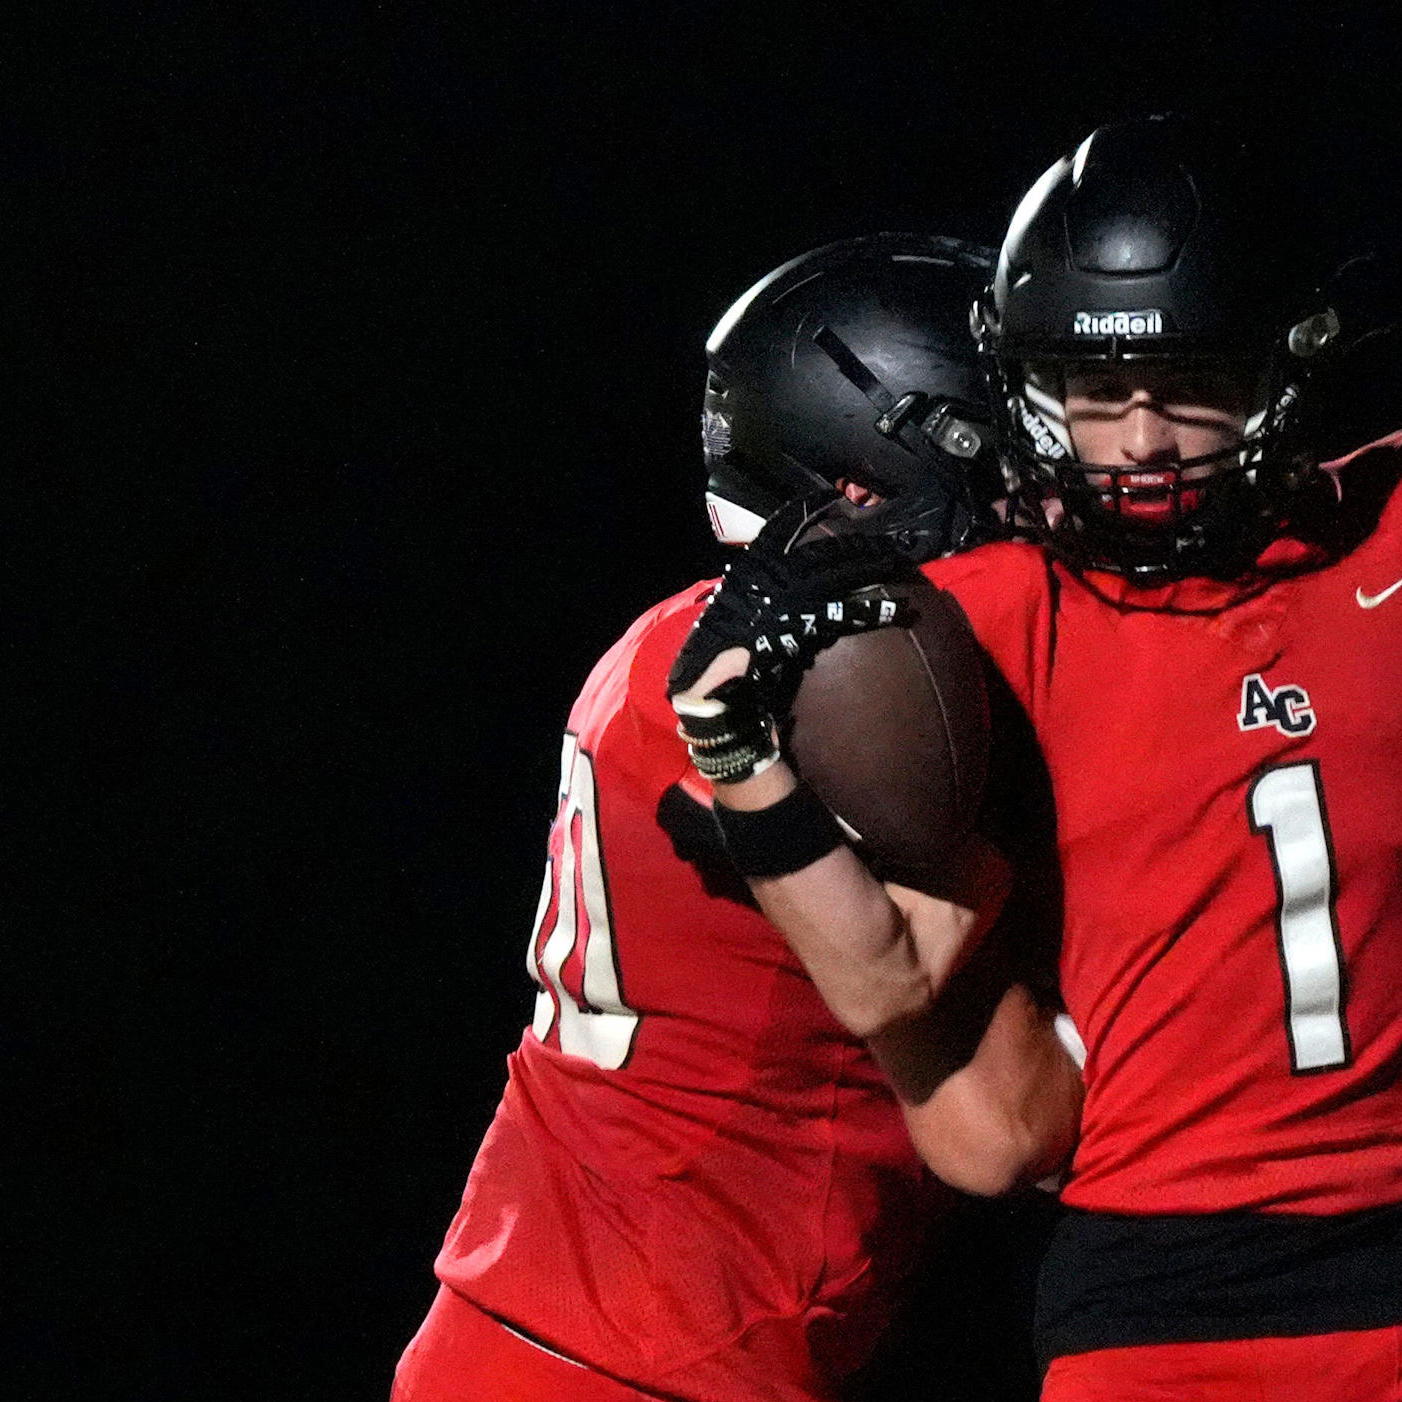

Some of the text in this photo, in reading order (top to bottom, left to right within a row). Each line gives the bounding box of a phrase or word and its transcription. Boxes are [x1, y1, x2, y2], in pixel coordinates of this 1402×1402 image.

[1073, 311, 1163, 335] Riddell
[1237, 673, 1317, 738] AC
[1246, 758, 1353, 1077] 1
